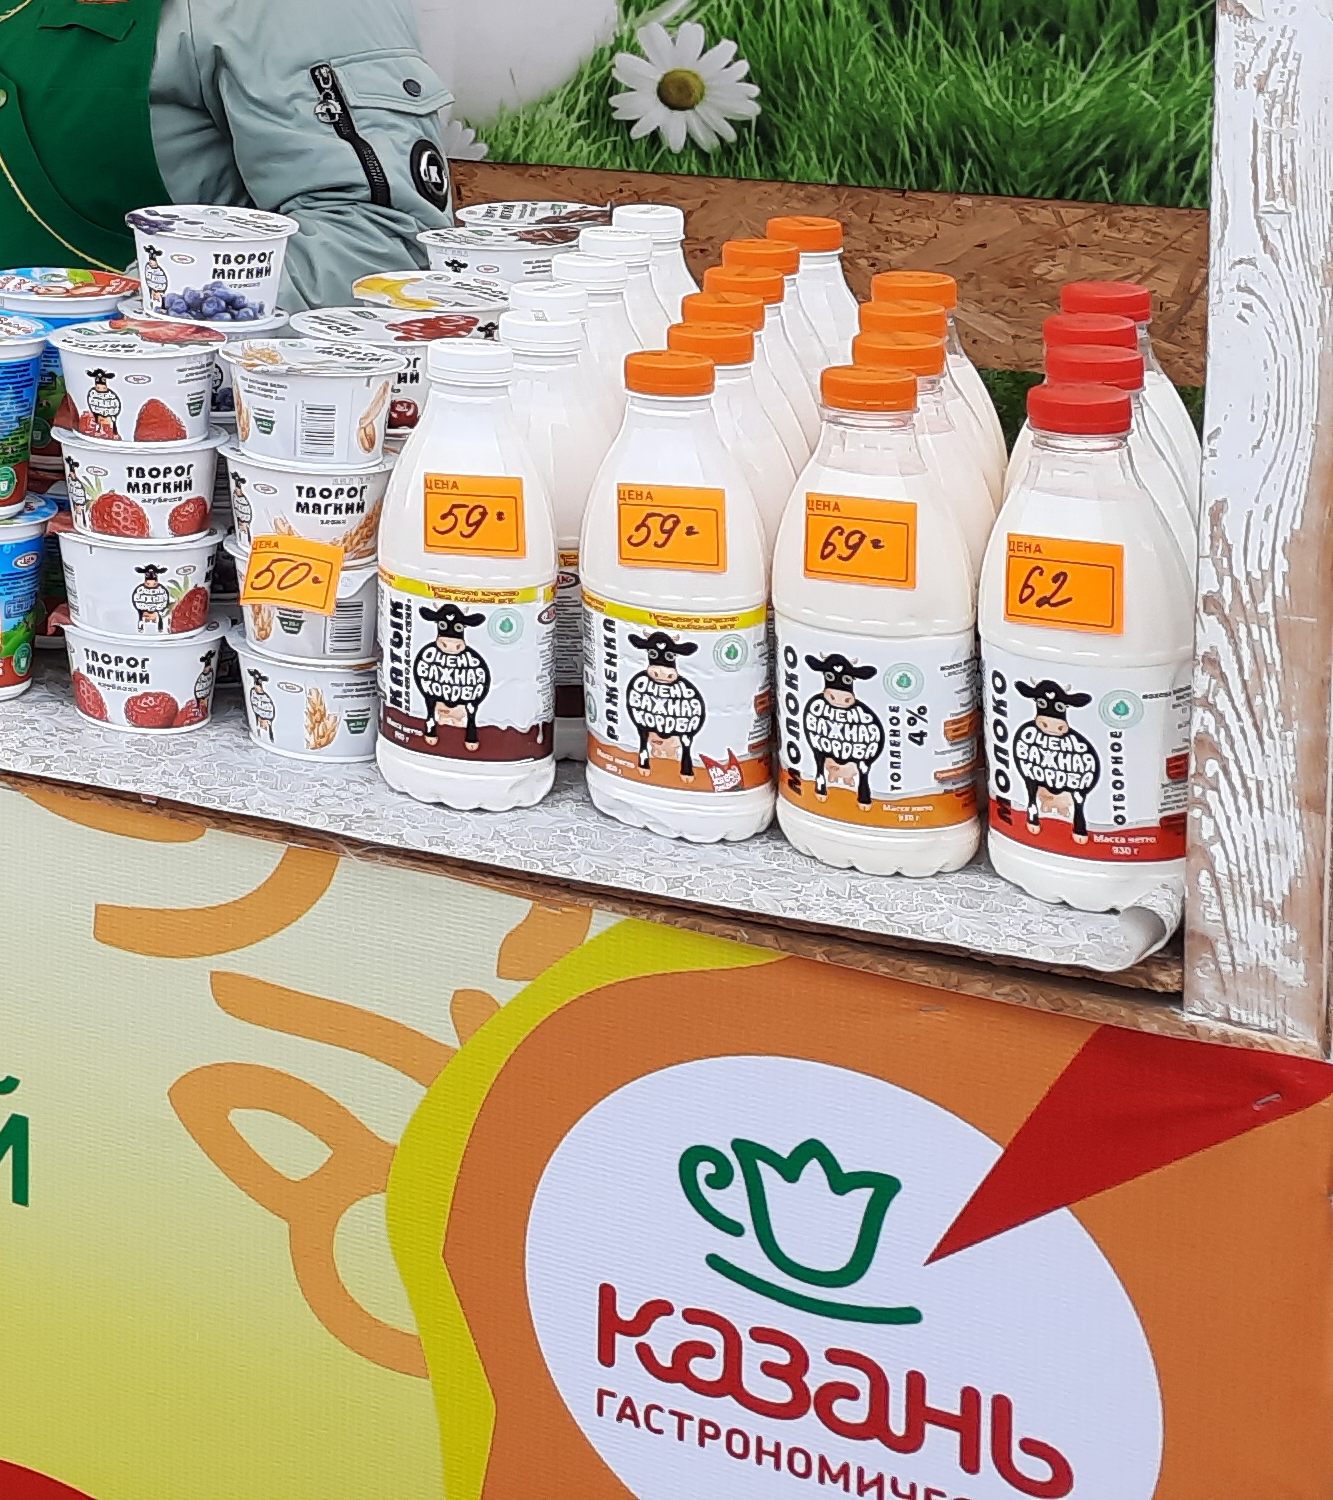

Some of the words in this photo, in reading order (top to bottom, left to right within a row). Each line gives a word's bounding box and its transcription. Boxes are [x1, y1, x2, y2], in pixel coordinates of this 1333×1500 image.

[212, 250, 274, 265] ТВОРОГ
[211, 265, 272, 280] МЯГКИЙ
[126, 464, 194, 479] ТВОРОГ
[126, 477, 193, 494] МЯГКИЙ
[295, 484, 367, 501] ТВОРОГ
[425, 479, 460, 491] ЦЕНА
[295, 501, 366, 515] МЯГКИЙ
[807, 500, 841, 513] ЦЕНА
[1008, 541, 1043, 554] ЦЕНА
[1018, 565, 1073, 608] 62
[84, 647, 150, 670] ТВОРОГ
[389, 599, 405, 710] КАТЫК
[421, 647, 480, 669] ОЧЕНЬ
[86, 663, 150, 684] МЯГКИЙ
[417, 664, 486, 686] ВАЖНАЯ
[603, 617, 619, 742] РЯЖЕНКА
[421, 679, 484, 702] КОРОВА
[633, 676, 695, 699] ОЧЕНЬ
[629, 690, 702, 718] ВАЖНАЯ
[810, 702, 874, 723] ОЧЕНЬ
[633, 709, 701, 734] КОРОВА
[784, 645, 802, 797] МОЛОКО
[805, 715, 880, 742] ВАЖНАЯ
[906, 705, 928, 747] 4%
[810, 734, 879, 760] КОРОВА
[889, 705, 902, 791] ТОПЛЕНОЕ
[992, 669, 1013, 826] МОЛОКО
[1020, 727, 1088, 753] ОЧЕНЬ
[1016, 742, 1096, 772] ВАЖНАЯ
[1021, 761, 1094, 790] КОРОВА
[1109, 730, 1126, 826] ОТБОРНОЕ
[596, 1387, 971, 1500] ГАСТРОНОМИЧ
